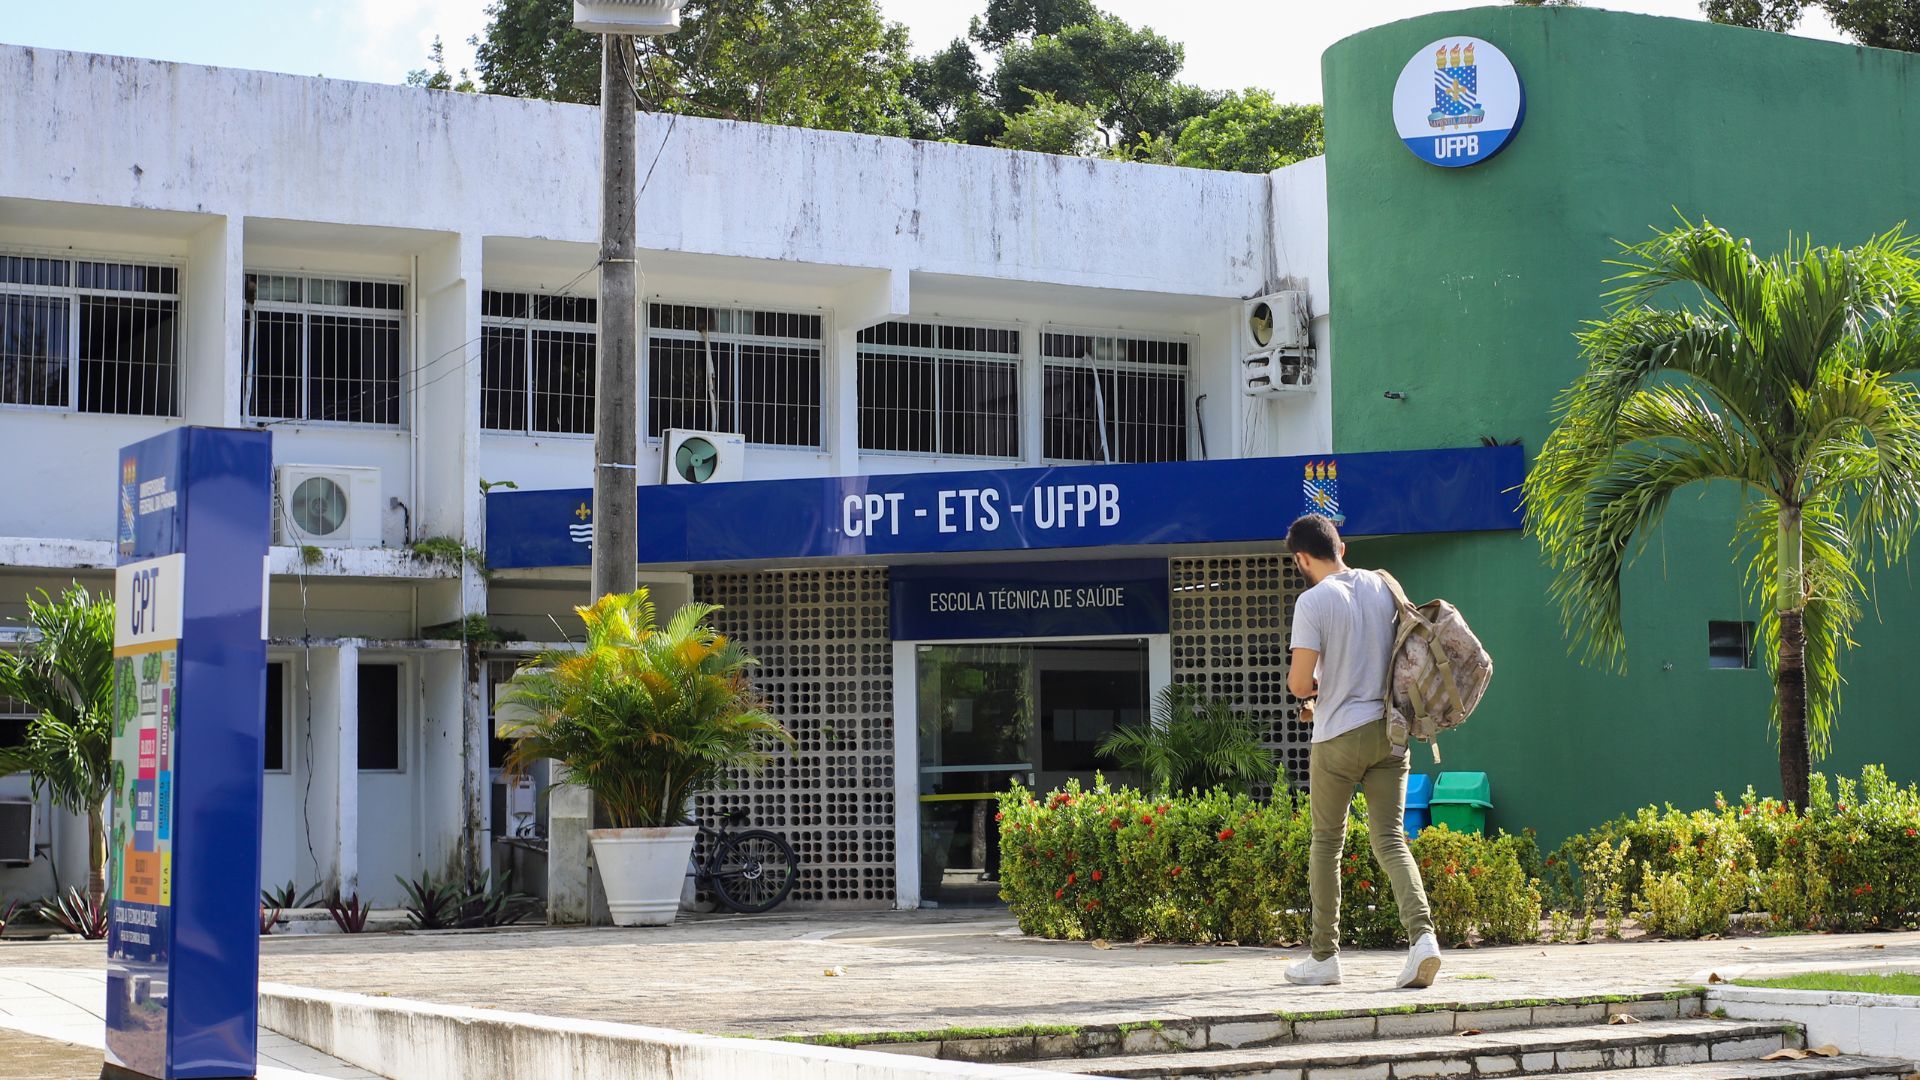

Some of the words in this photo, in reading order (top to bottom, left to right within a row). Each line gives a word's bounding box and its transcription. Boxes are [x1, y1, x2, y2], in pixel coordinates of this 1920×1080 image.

[1434, 135, 1479, 159] UFPB
[843, 493, 905, 537] CPT
[938, 488, 1000, 533] ETS
[1034, 483, 1120, 529] UFPB
[132, 567, 159, 636] CPT
[930, 592, 985, 612] ESCOLA
[989, 587, 1050, 610] TÉCNICA
[1054, 589, 1072, 608] DE
[1076, 584, 1124, 607] SAÚDE
